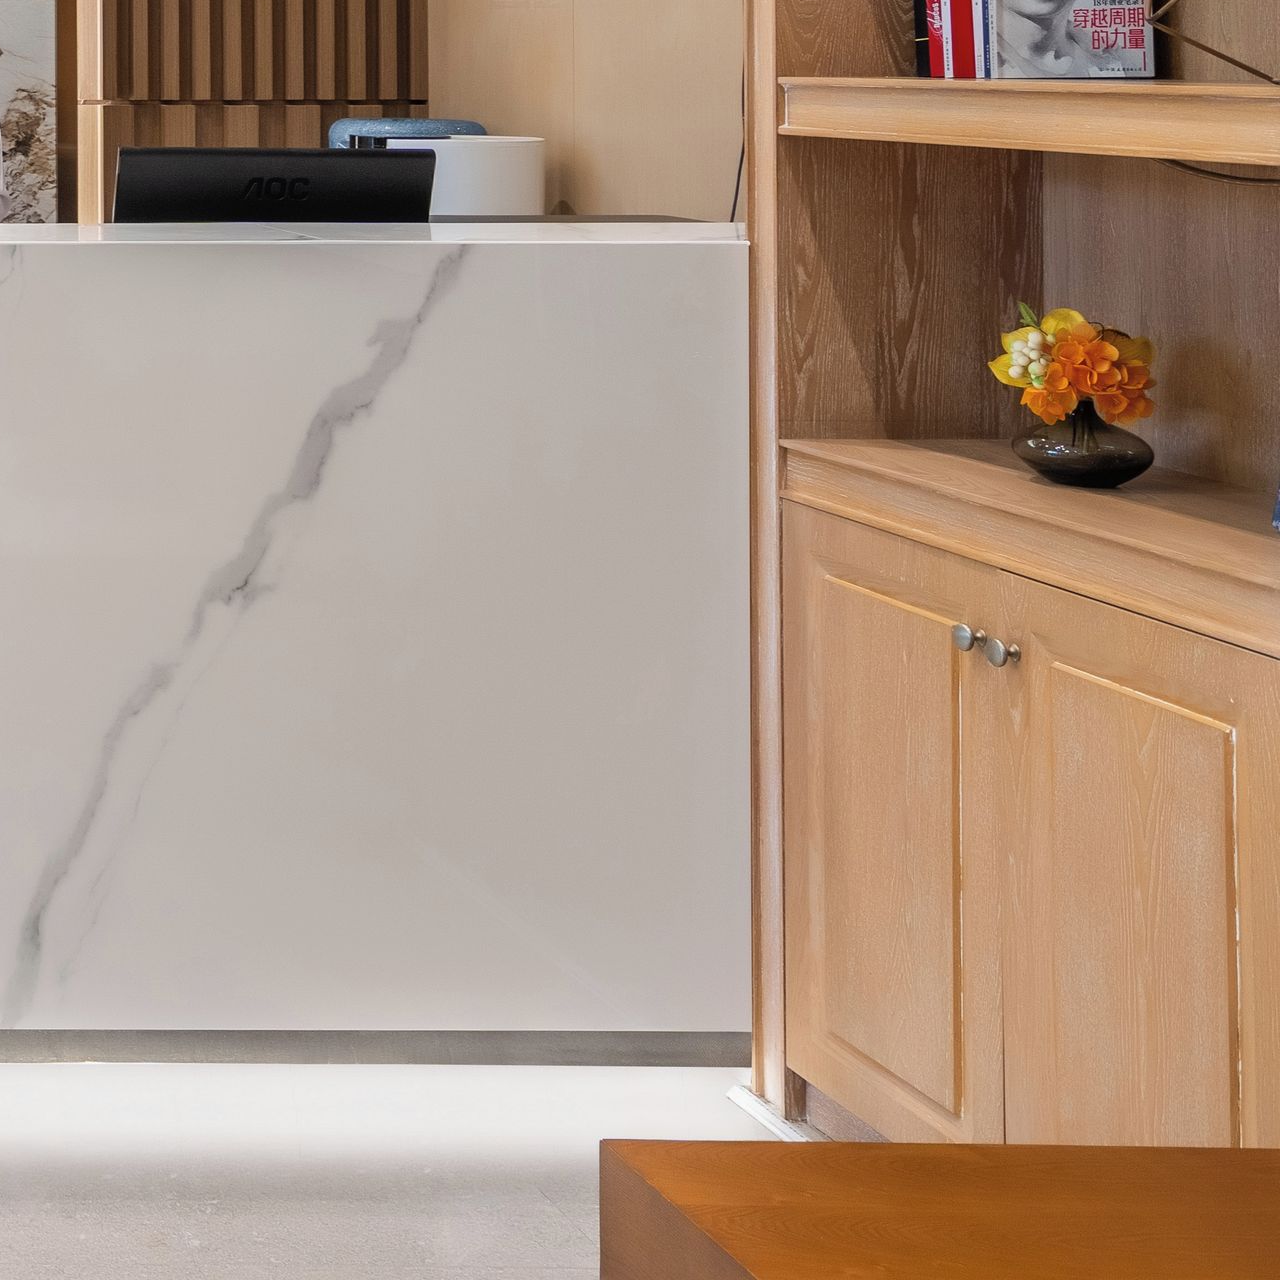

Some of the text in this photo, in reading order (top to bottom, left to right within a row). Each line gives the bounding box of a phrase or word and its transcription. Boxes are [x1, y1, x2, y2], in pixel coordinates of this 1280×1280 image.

[1073, 7, 1145, 29] 穿越周期
[1092, 28, 1146, 50] 的力量
[240, 177, 311, 201] AOC
